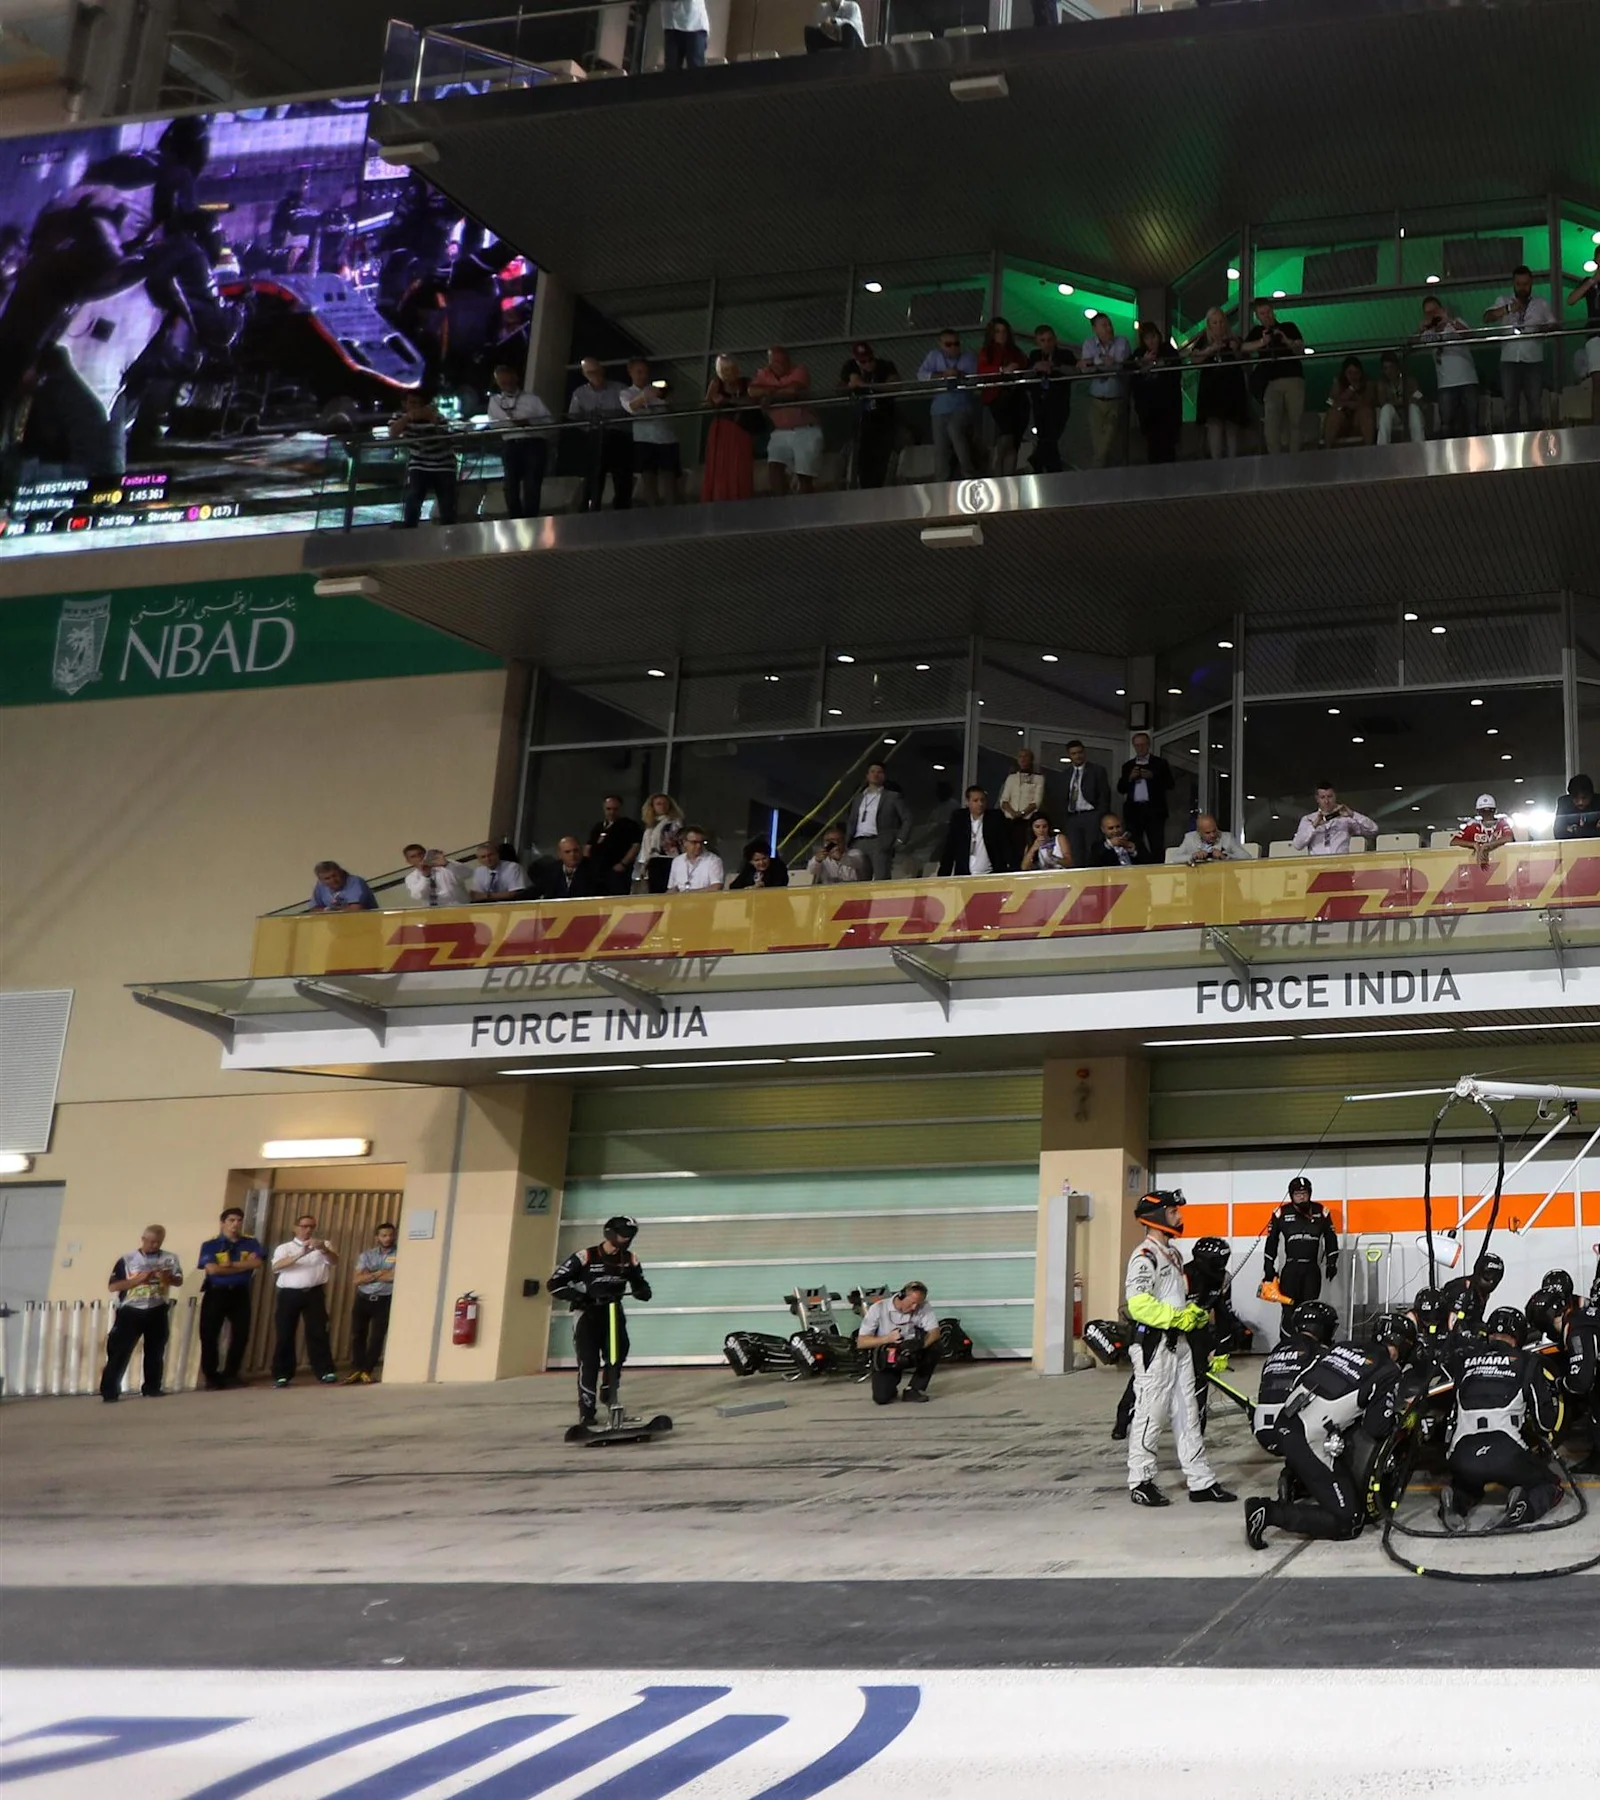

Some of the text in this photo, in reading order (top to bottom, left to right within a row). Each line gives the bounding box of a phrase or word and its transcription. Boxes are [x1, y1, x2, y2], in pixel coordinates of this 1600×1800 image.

[36, 481, 88, 495] VERSTAPPEN
[121, 474, 167, 486] Fastest Lap
[48, 498, 74, 509] Racing
[119, 617, 296, 682] NBAD
[831, 884, 1146, 946] DHL
[385, 911, 682, 971] DHL
[1197, 968, 1461, 1014] FORCE INDIA
[471, 1005, 709, 1048] FORCE INDIA
[527, 1189, 548, 1209] 22
[1464, 1355, 1511, 1369] SAHARA
